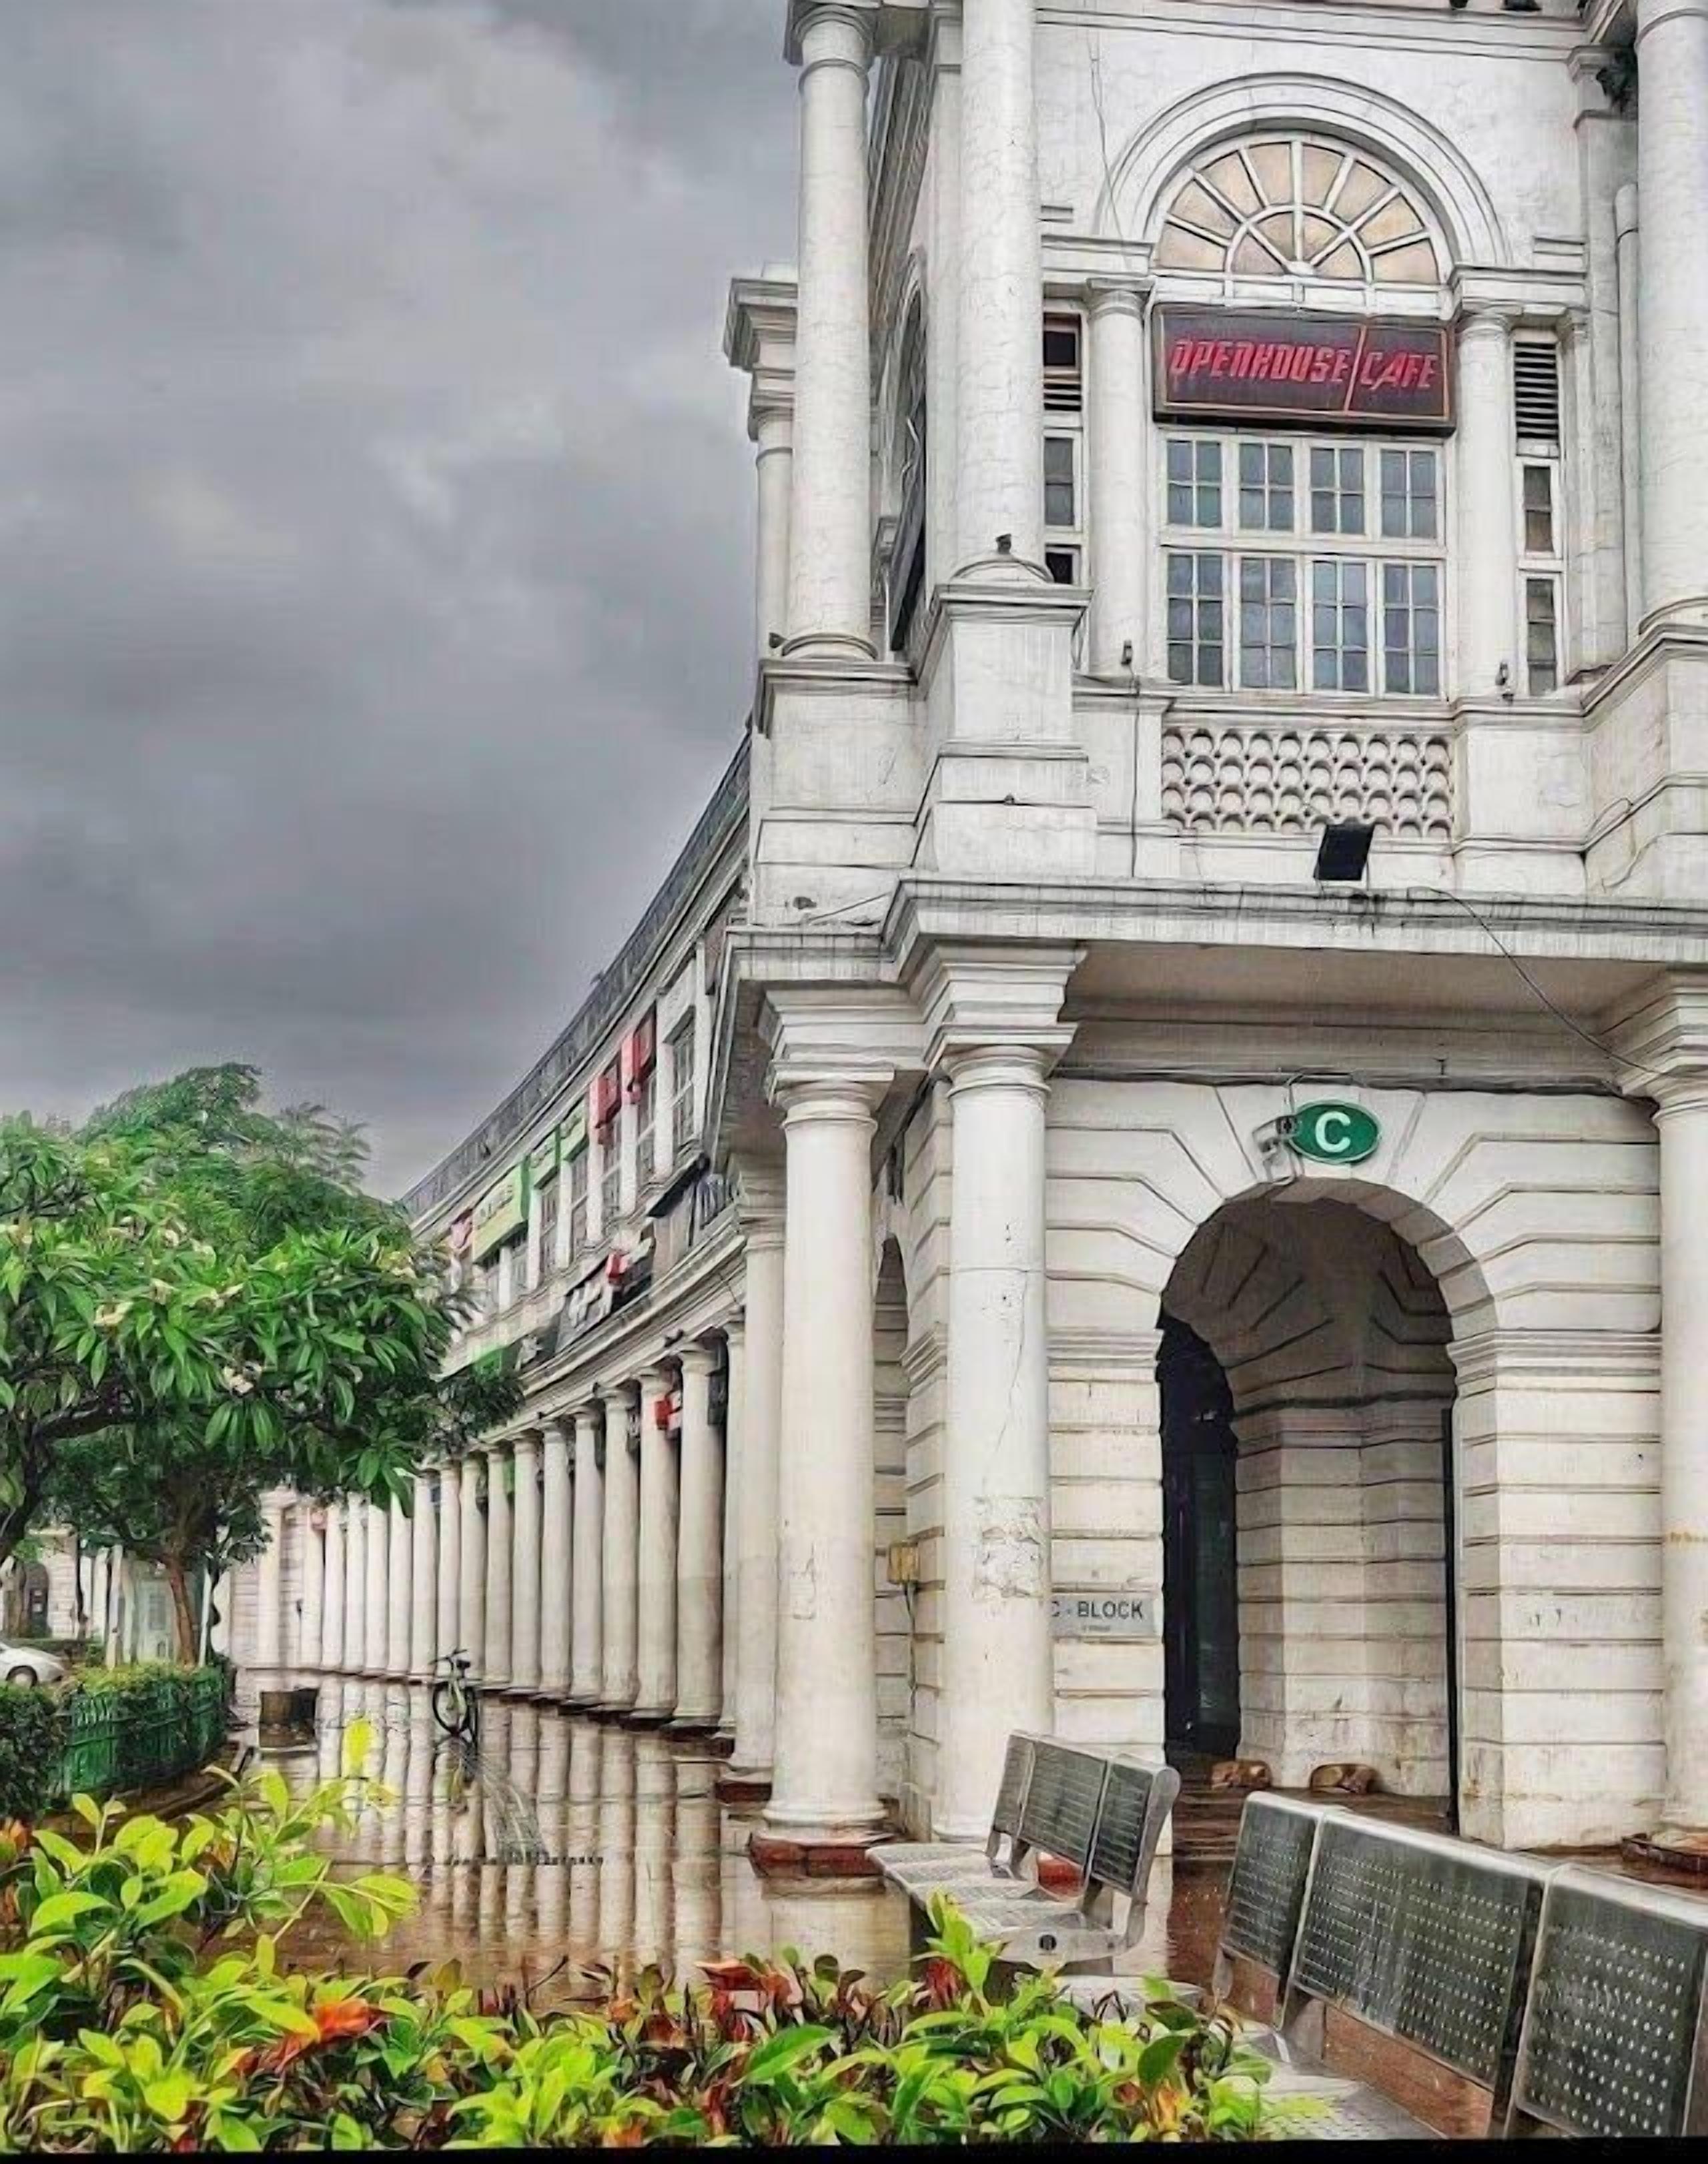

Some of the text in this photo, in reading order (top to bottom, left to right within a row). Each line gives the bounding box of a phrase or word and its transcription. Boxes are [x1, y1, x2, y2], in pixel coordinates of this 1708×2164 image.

[1169, 340, 1439, 390] OPENHOUSE CAFE
[1315, 1111, 1351, 1153] C
